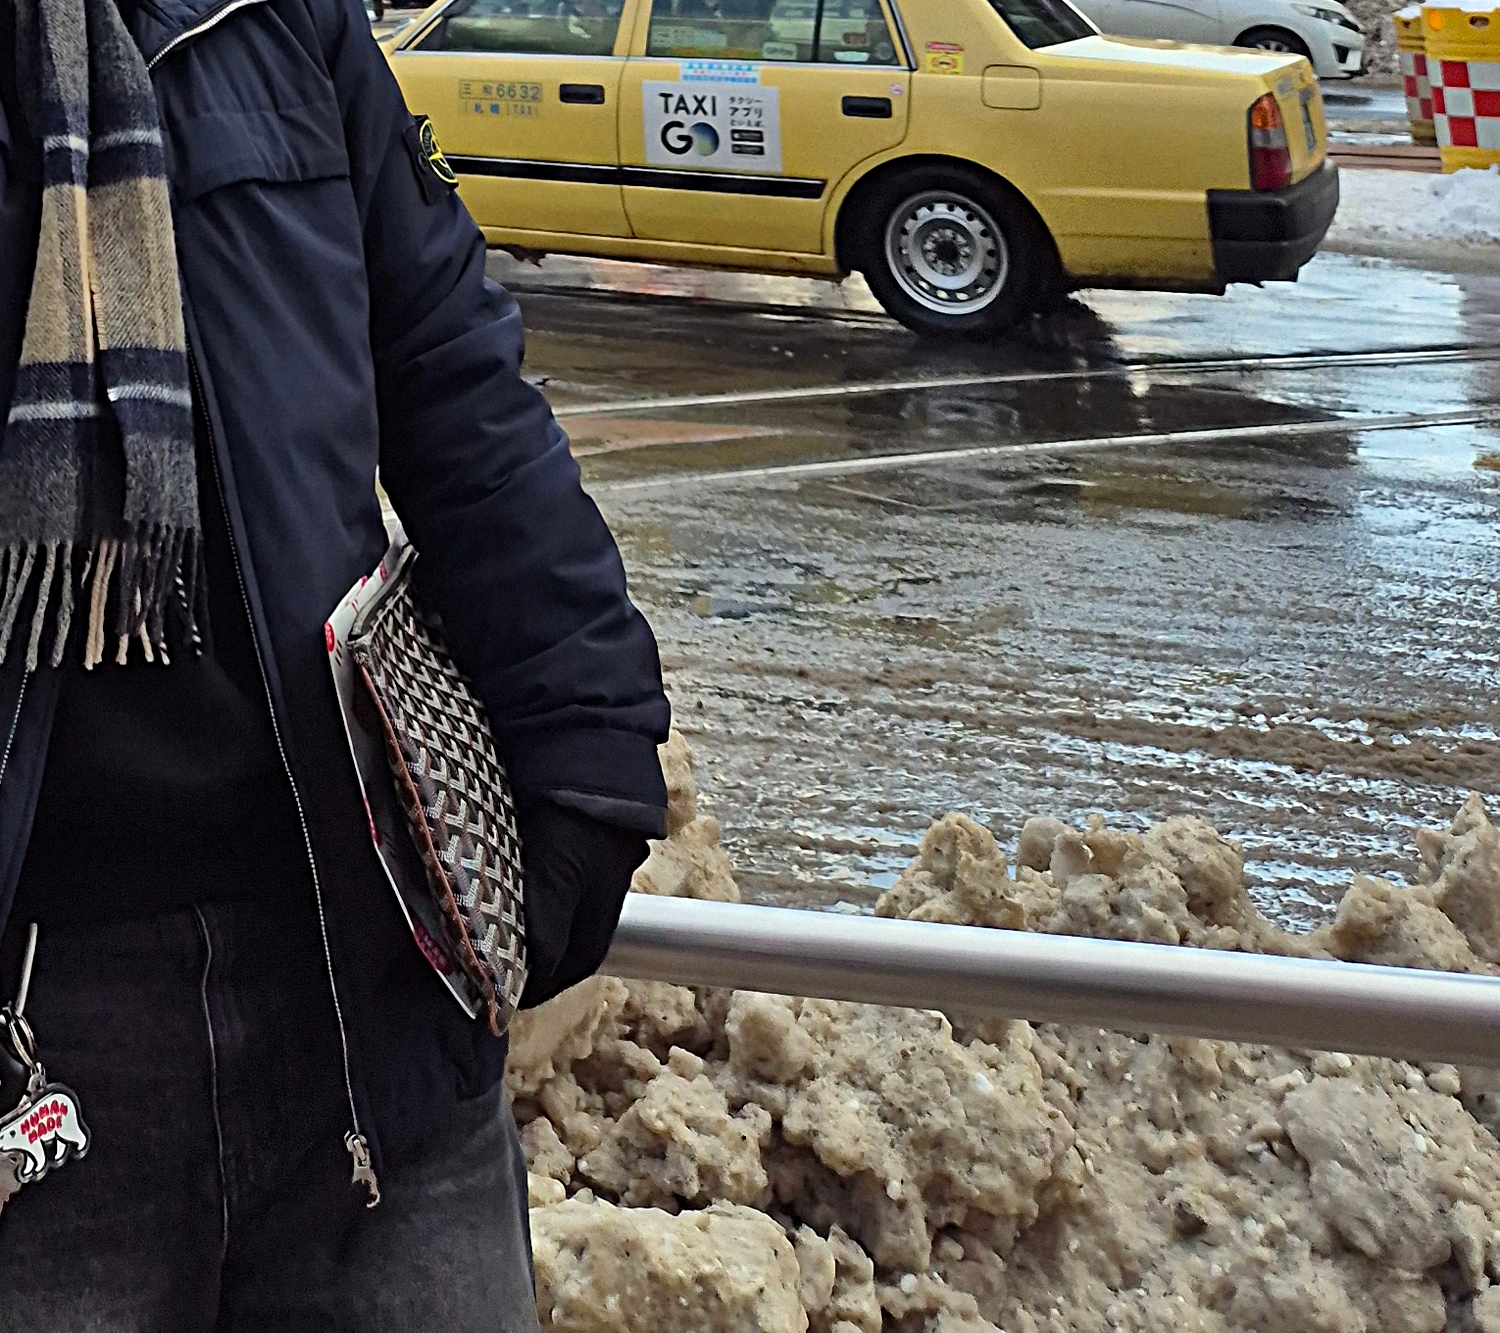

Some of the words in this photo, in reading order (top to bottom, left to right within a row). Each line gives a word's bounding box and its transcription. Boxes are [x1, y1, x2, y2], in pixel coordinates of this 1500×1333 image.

[495, 82, 541, 102] 6632
[729, 95, 764, 105] タクシー
[657, 91, 718, 117] TAXI
[729, 106, 764, 119] アプリ
[20, 1099, 69, 1136] HUMAN
[29, 1114, 64, 1145] MADE
